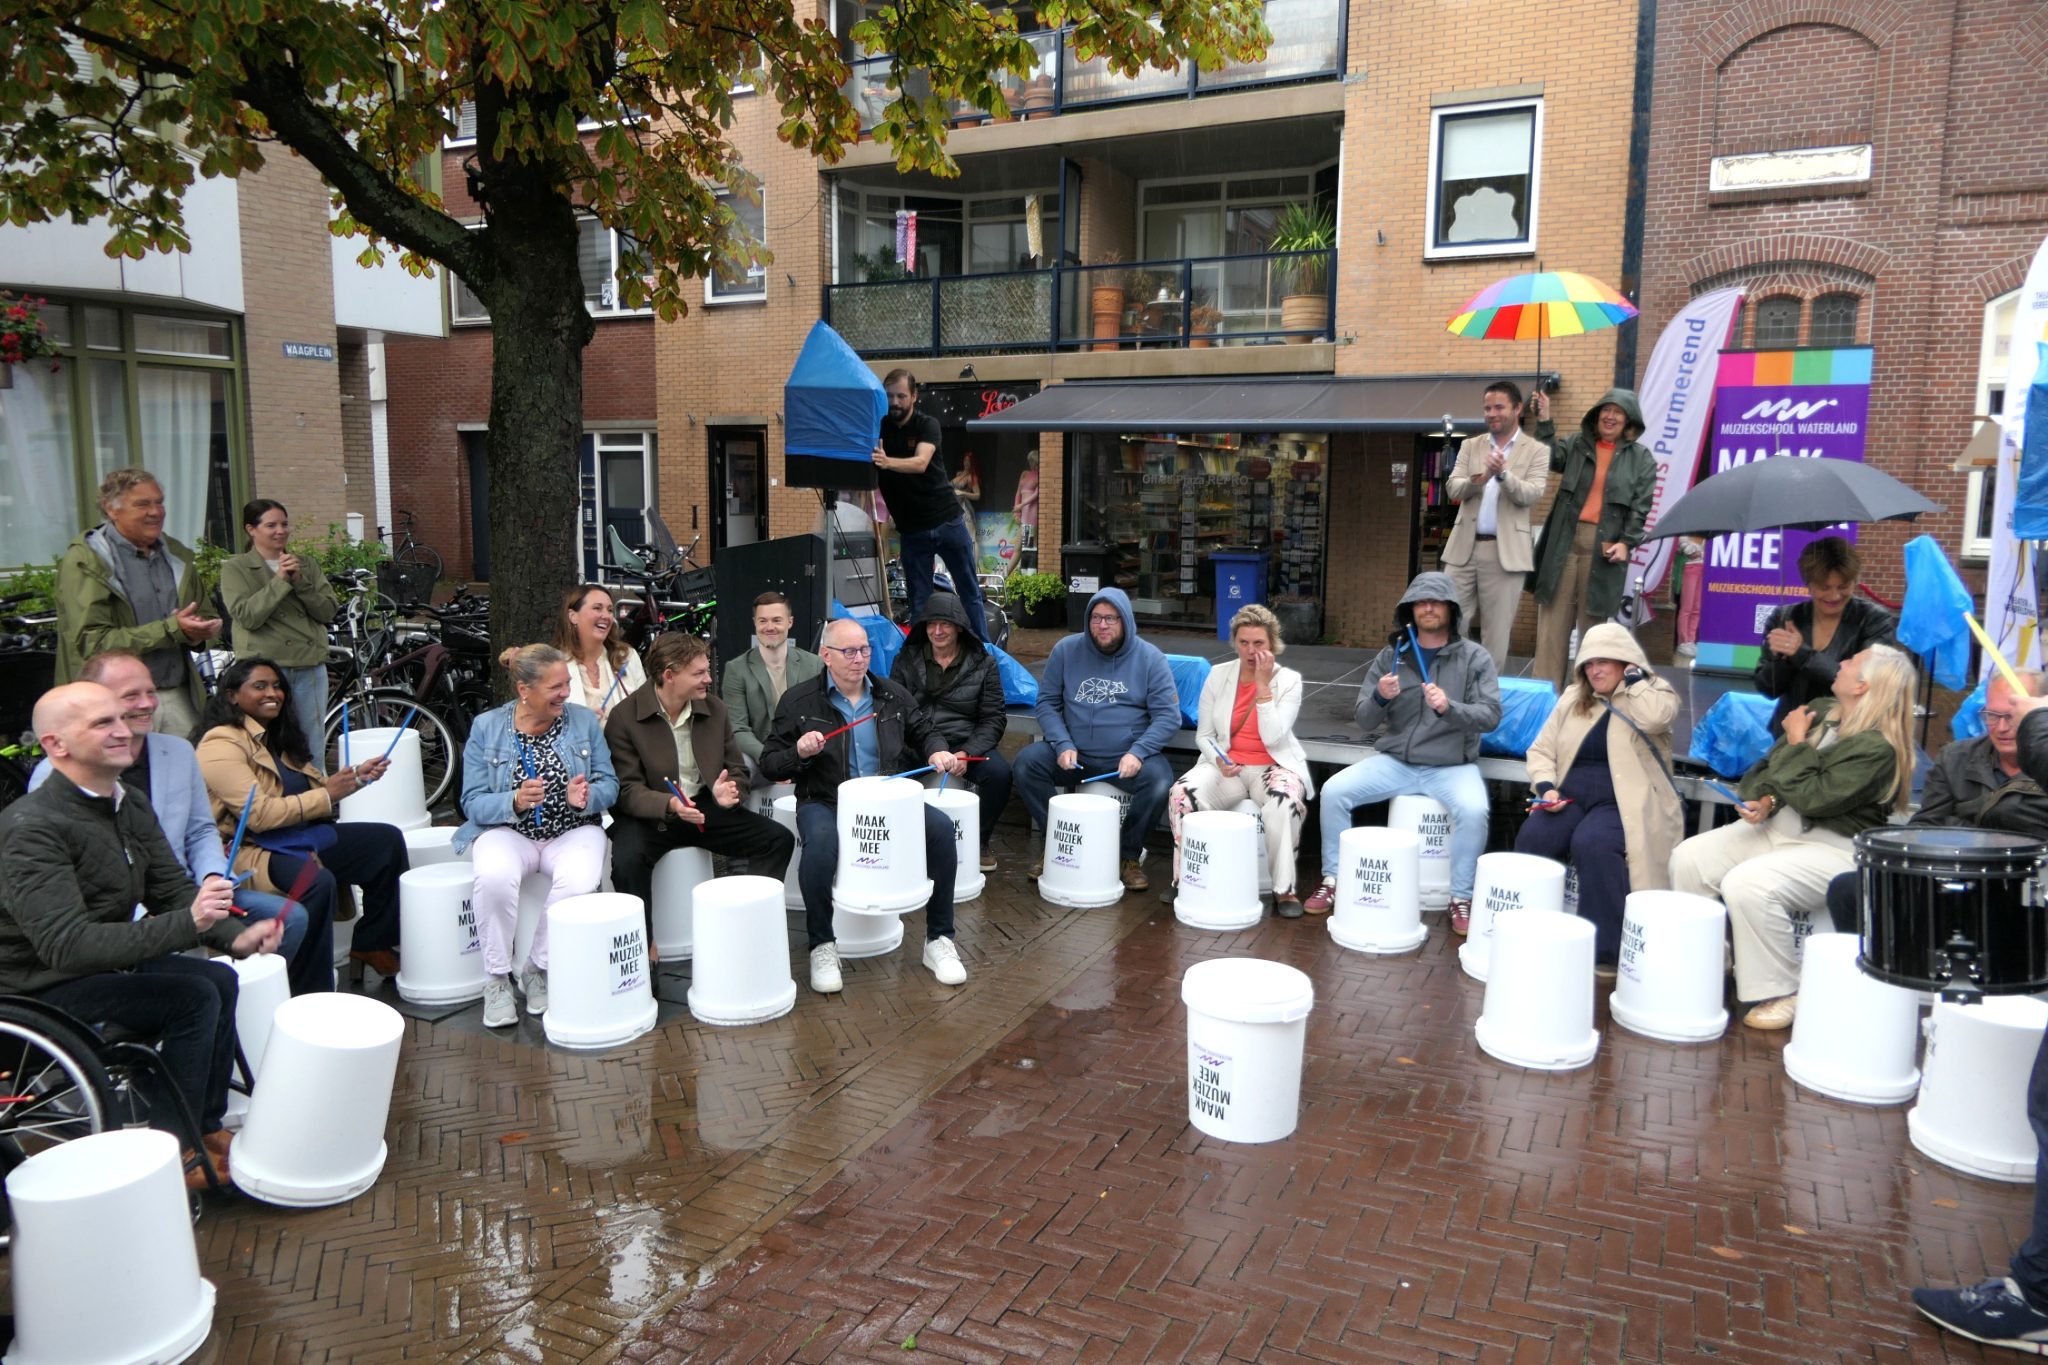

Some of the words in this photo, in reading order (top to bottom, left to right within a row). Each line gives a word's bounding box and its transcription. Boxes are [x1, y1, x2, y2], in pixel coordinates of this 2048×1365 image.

[285, 344, 332, 358] WAAGPLEIN
[1720, 423, 1795, 435] MUZIEKSCHOOL
[1797, 422, 1858, 434] WATERLAND
[1629, 462, 1669, 567] Fiuis
[1653, 317, 1706, 456] Purmerend
[1207, 474, 1249, 486] REPRO
[1711, 532, 1781, 570] MEE
[761, 797, 774, 808] MA
[855, 813, 886, 828] MAAK
[1421, 813, 1448, 824] MAAK
[851, 827, 890, 841] MUZIEK
[1057, 819, 1081, 834] MAAK
[1418, 824, 1450, 835] MUZIEK
[1053, 831, 1083, 846] MUZIEK
[1186, 836, 1207, 852] MAAK
[1425, 836, 1443, 846] MEE
[859, 841, 880, 854] MEE
[1058, 843, 1074, 856] MEE
[1183, 847, 1209, 865] MUZIEK
[1187, 861, 1201, 875] MEE
[1359, 857, 1389, 871] MAAK
[1355, 868, 1392, 883] MUZIEK
[1362, 882, 1382, 895] MEE
[1490, 886, 1521, 903] MAAK
[1623, 918, 1644, 938] MAAK
[613, 929, 641, 949] MAAK
[609, 942, 643, 965] MUZIEK
[1622, 946, 1636, 964] MEE
[620, 961, 640, 977] MEE
[1199, 1065, 1220, 1086] MEE
[1192, 1075, 1231, 1105] MUZIEK
[1194, 1094, 1225, 1120] MAAK
